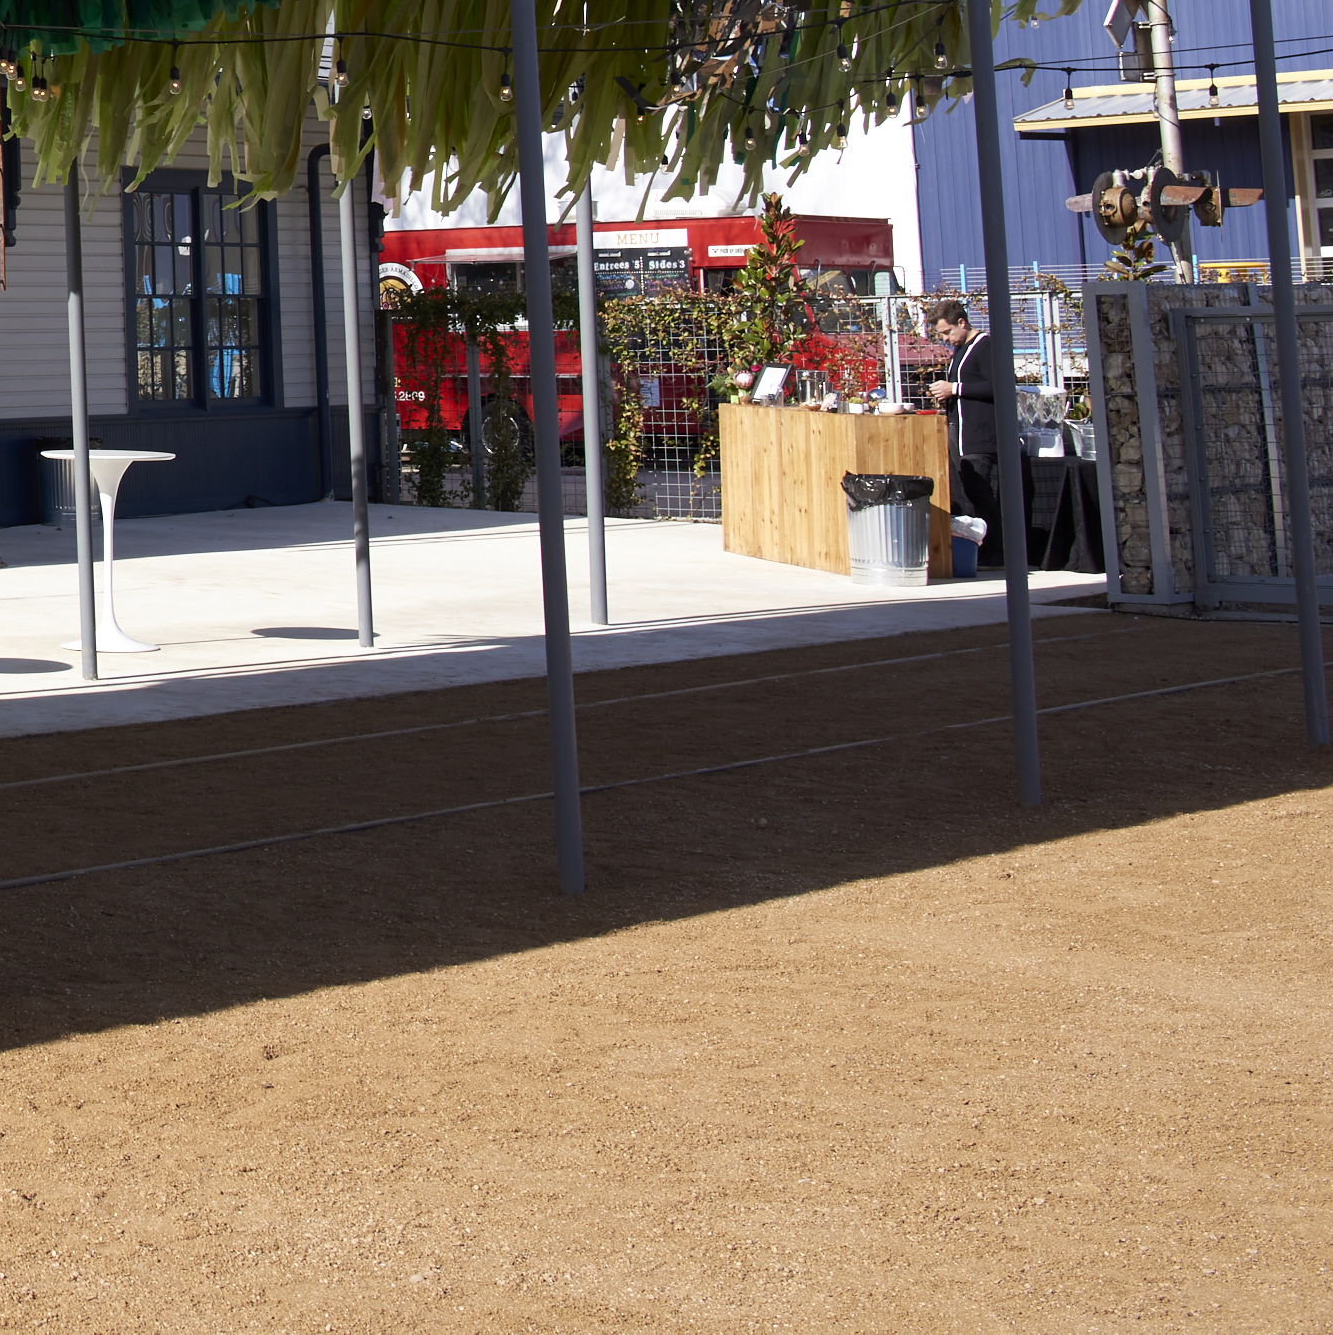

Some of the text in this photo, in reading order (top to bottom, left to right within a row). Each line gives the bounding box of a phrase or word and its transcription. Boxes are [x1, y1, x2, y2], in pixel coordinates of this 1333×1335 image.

[617, 232, 659, 245] MENU
[594, 261, 630, 271] Entrees
[649, 259, 677, 270] Sides
